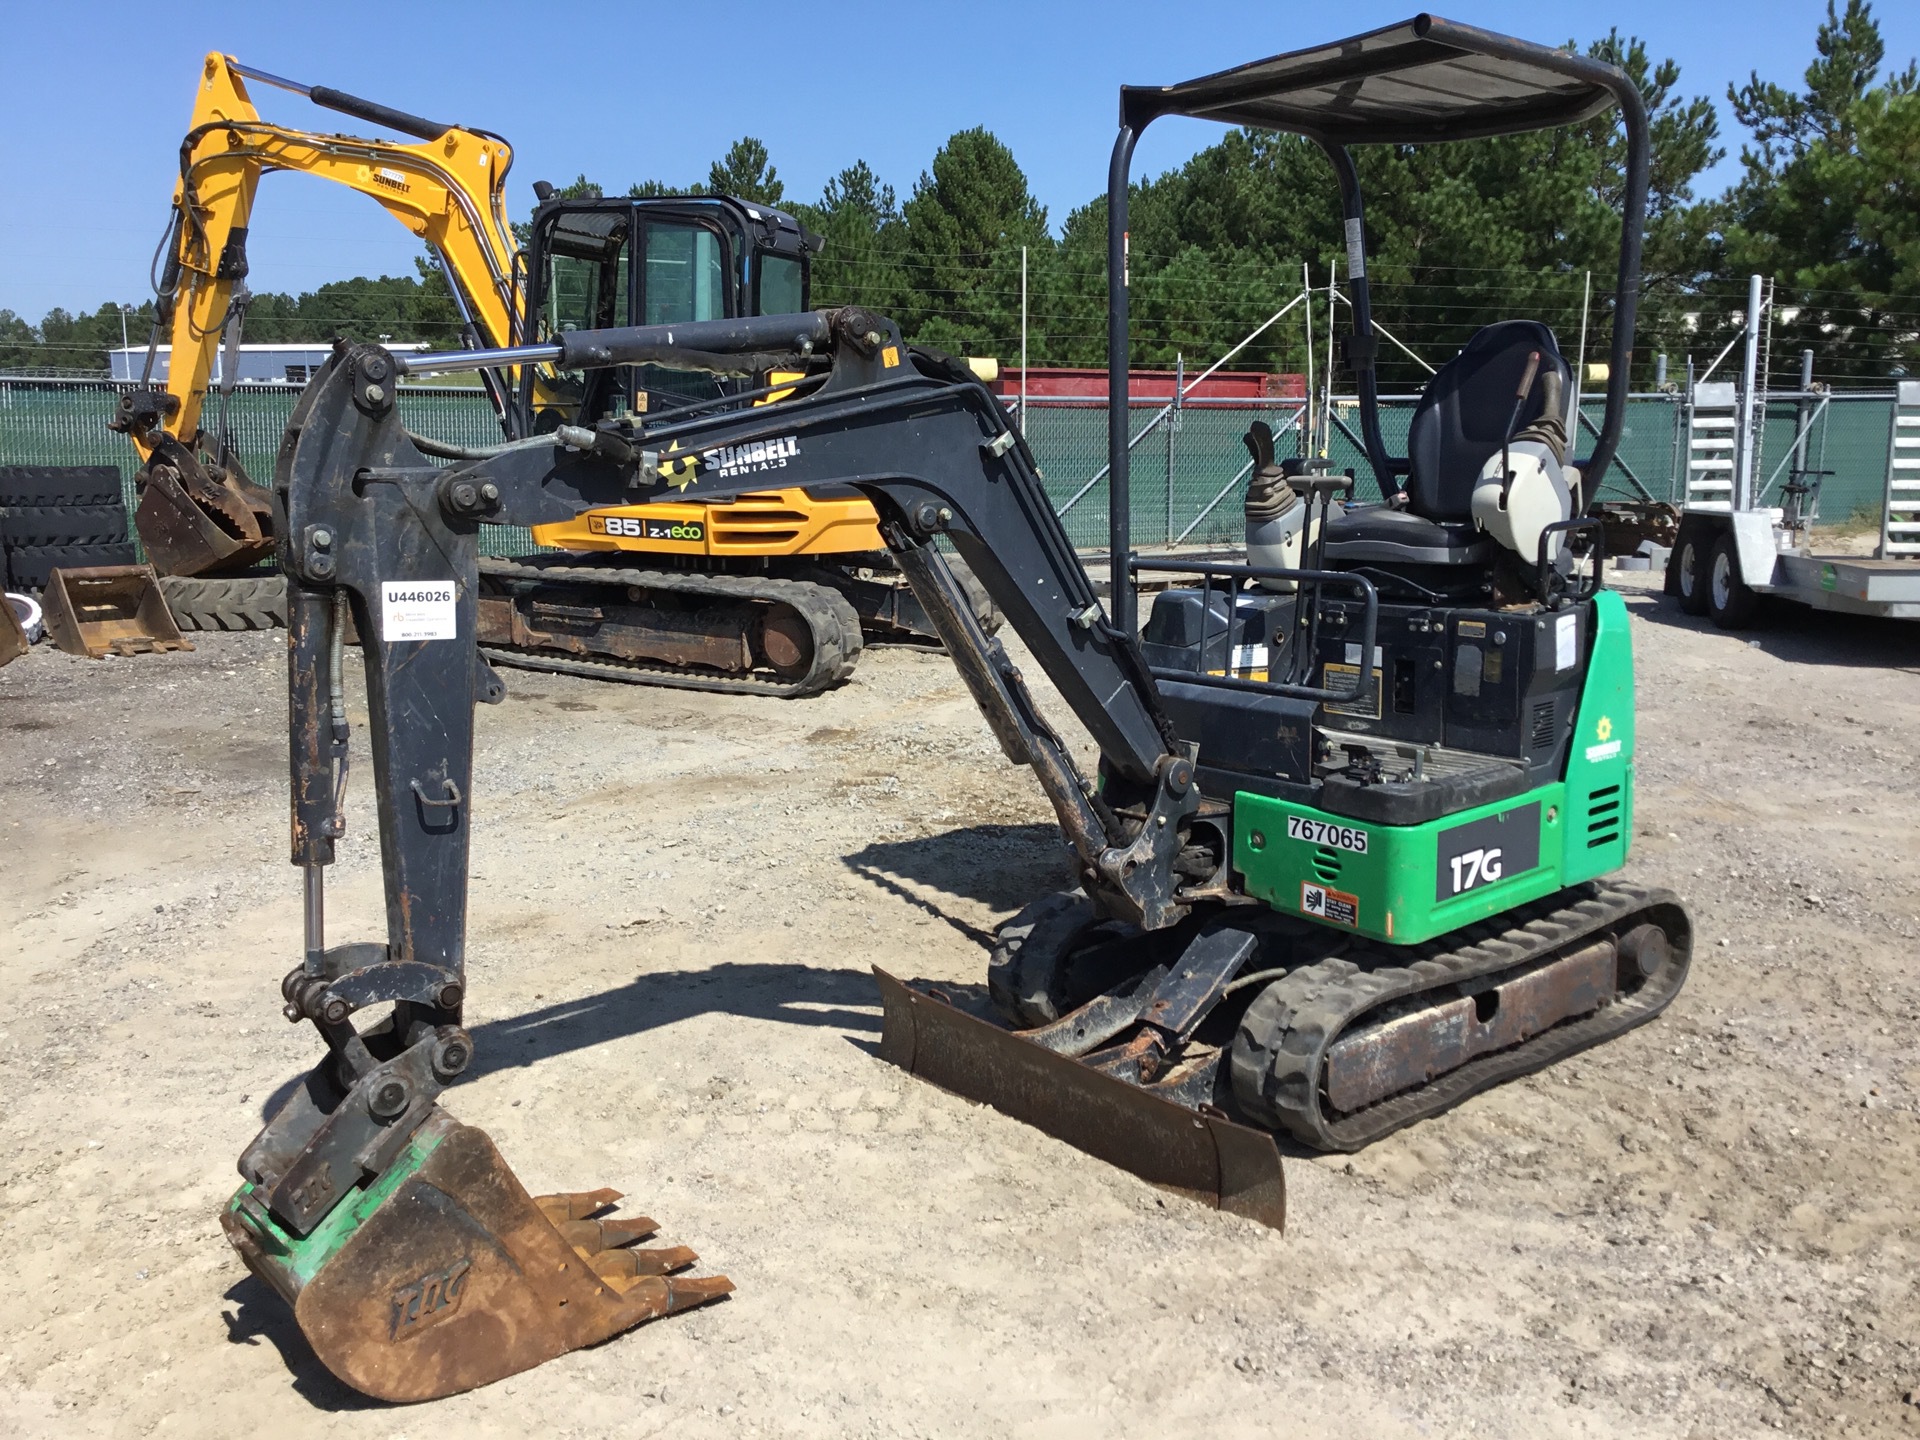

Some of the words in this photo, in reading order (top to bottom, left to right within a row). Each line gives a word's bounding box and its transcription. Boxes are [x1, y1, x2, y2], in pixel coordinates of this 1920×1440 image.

[373, 173, 411, 193] SUNBELT
[703, 436, 797, 470] SUNBELT
[605, 518, 640, 536] 85
[388, 591, 451, 603] U446026
[1289, 816, 1366, 852] 767065
[1451, 848, 1502, 893] 17G
